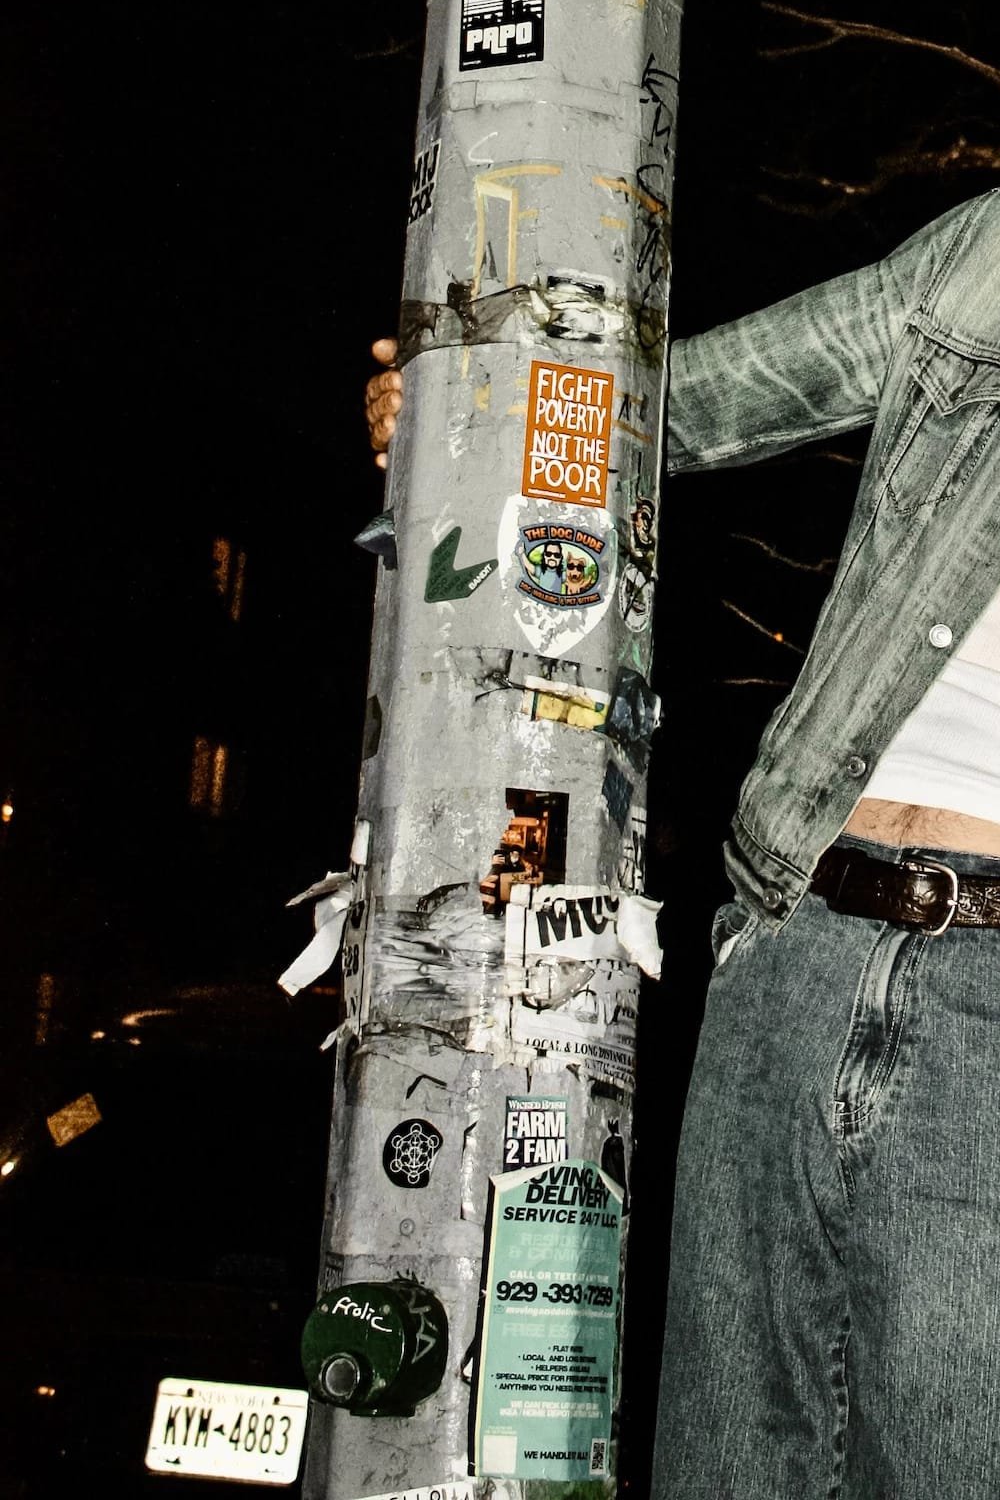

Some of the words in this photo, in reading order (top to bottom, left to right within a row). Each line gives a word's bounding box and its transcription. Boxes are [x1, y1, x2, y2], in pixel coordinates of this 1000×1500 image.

[537, 367, 608, 406] FIGHT
[535, 396, 607, 436] POVERTY
[532, 428, 571, 460] NOT
[573, 435, 606, 464] THE
[530, 456, 601, 496] POOR
[524, 527, 547, 540] THE
[550, 527, 573, 540] DOG
[576, 532, 604, 552] DUDE
[564, 1041, 571, 1053] &
[574, 1042, 598, 1057] LONG
[506, 1111, 566, 1138] FARM
[506, 1138, 520, 1164] 2
[523, 1139, 566, 1164] FAM
[524, 1166, 594, 1188] OVING
[525, 1184, 611, 1209] DELIVERY
[503, 1206, 577, 1224] SERVICE
[509, 1270, 535, 1280] CALL
[536, 1271, 551, 1280] OR
[552, 1272, 576, 1282] TEXT
[496, 1280, 538, 1302] 929
[522, 1354, 546, 1362] LOCAL
[496, 1373, 526, 1381] SPECIAL
[499, 1383, 537, 1391] ANYTHING
[228, 1411, 292, 1456] 4883
[524, 1450, 538, 1460] WE
